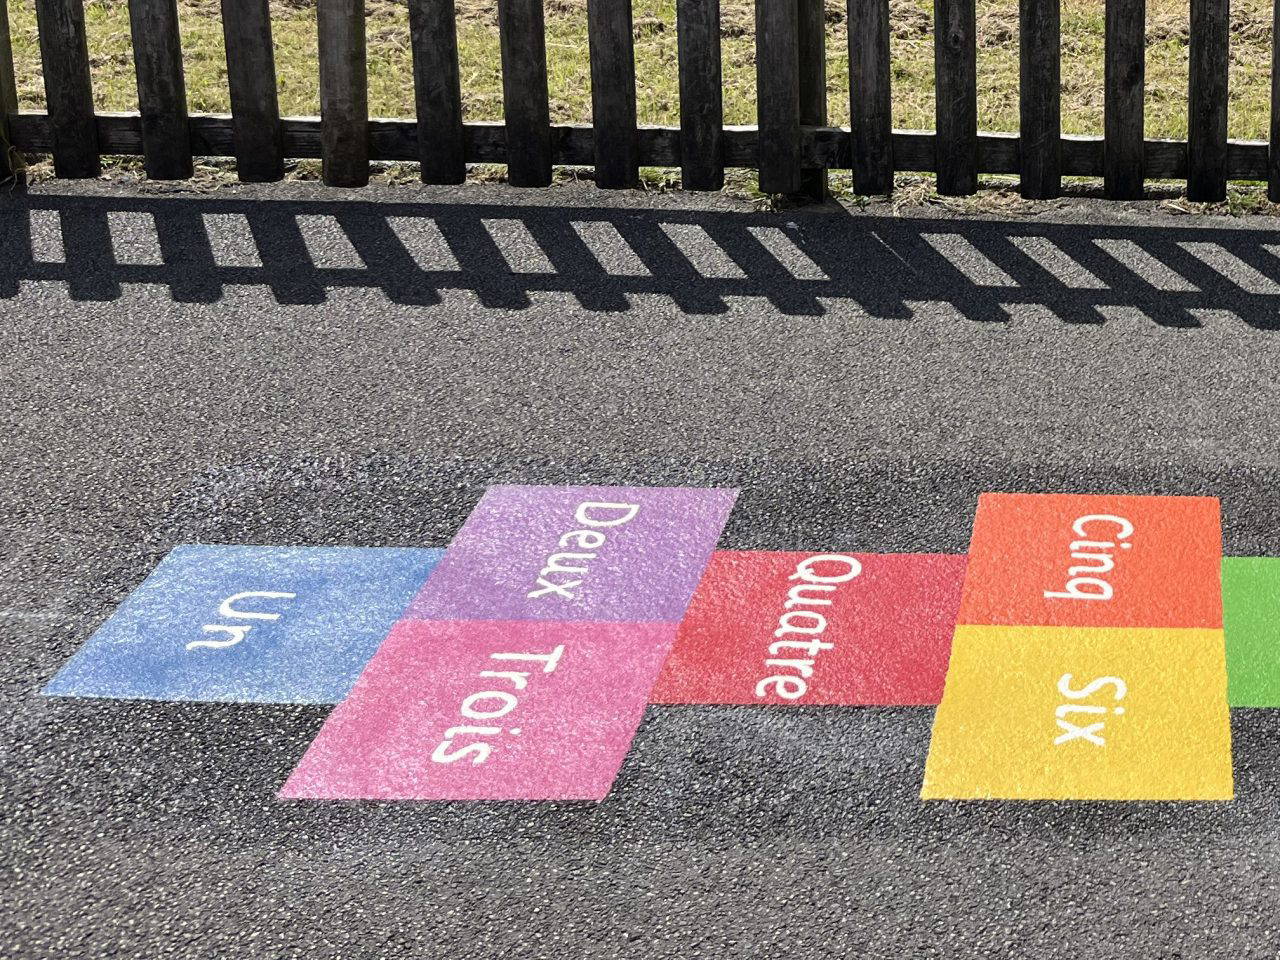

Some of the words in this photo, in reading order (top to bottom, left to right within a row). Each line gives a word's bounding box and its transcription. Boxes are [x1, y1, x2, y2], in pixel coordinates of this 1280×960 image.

[528, 501, 639, 600] Deux
[1044, 514, 1134, 600] Cinq
[186, 591, 295, 650] Un
[755, 553, 862, 699] Quatre
[431, 645, 564, 765] Trois
[1054, 673, 1127, 746] Six
